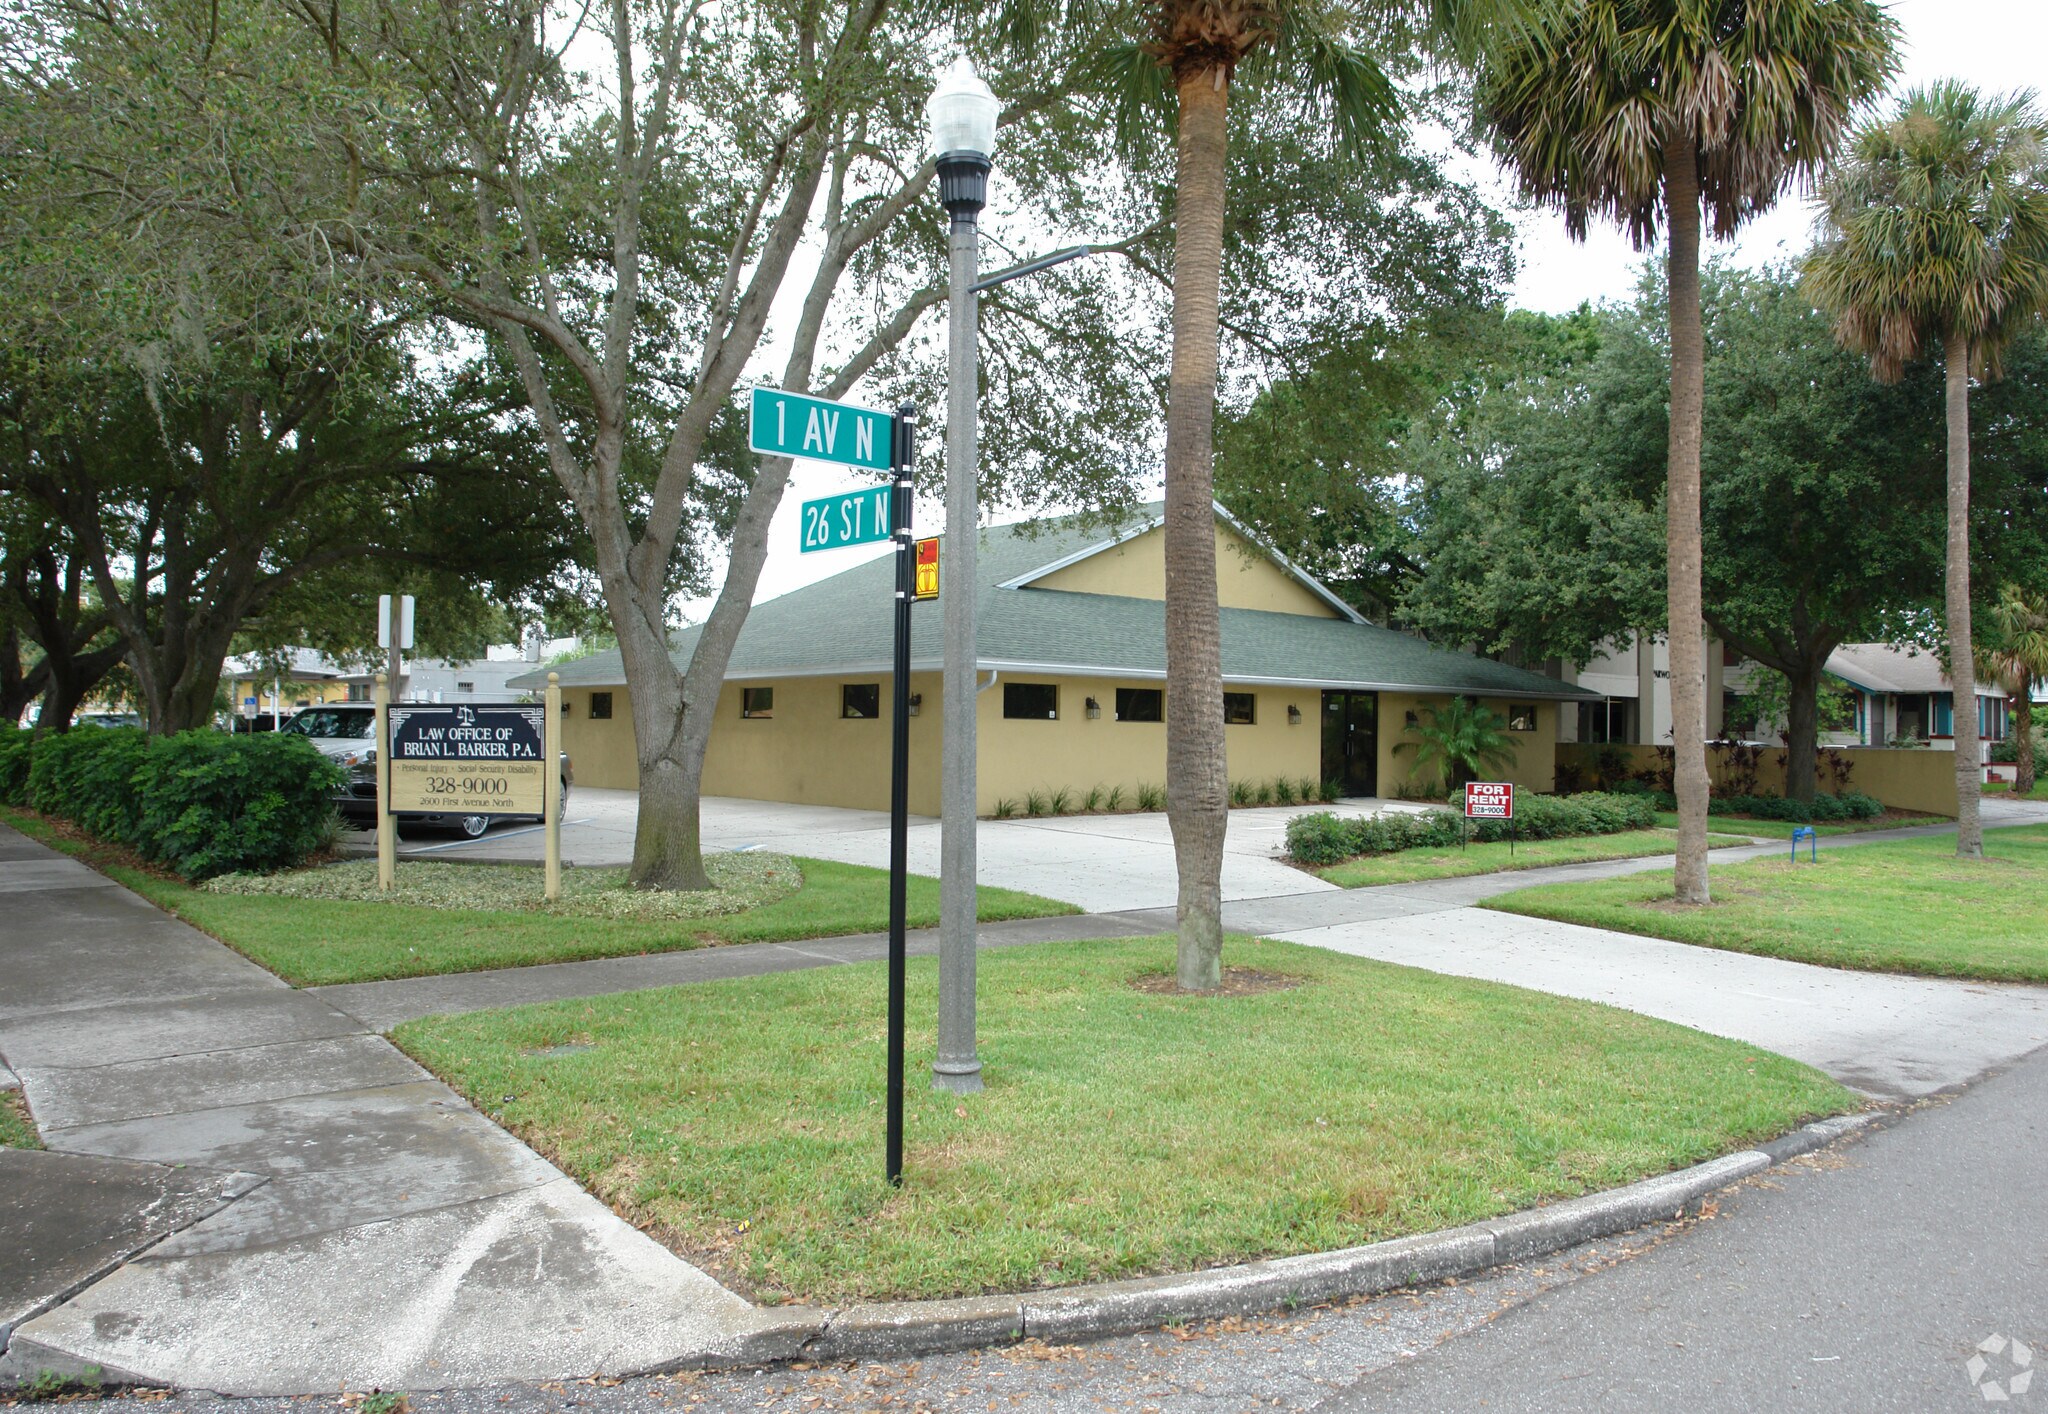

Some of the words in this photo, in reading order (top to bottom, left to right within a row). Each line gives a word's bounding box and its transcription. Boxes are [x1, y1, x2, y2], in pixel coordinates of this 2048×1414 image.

[776, 401, 785, 446] 1
[803, 407, 839, 454] AV
[856, 416, 873, 461] N
[806, 505, 829, 547] 26
[840, 497, 864, 541] ST
[875, 492, 888, 535] N
[419, 728, 445, 740] LAW
[449, 728, 491, 740] OFFICE
[495, 728, 513, 740] OF
[404, 742, 439, 756] BRIAN
[444, 743, 454, 756] L.
[458, 743, 509, 758] BARKER,
[513, 743, 536, 757] P.A.
[402, 764, 428, 772] Personal
[430, 764, 448, 774] Injury
[458, 765, 476, 773] Social
[480, 765, 505, 774] Security
[508, 766, 537, 775] Disability
[425, 777, 507, 794] 328-9000
[1474, 786, 1504, 794] FOR
[420, 798, 439, 806] 2600
[442, 798, 459, 806] First
[461, 798, 489, 807] Avenue
[492, 799, 513, 807] North
[1469, 795, 1509, 804] RENT
